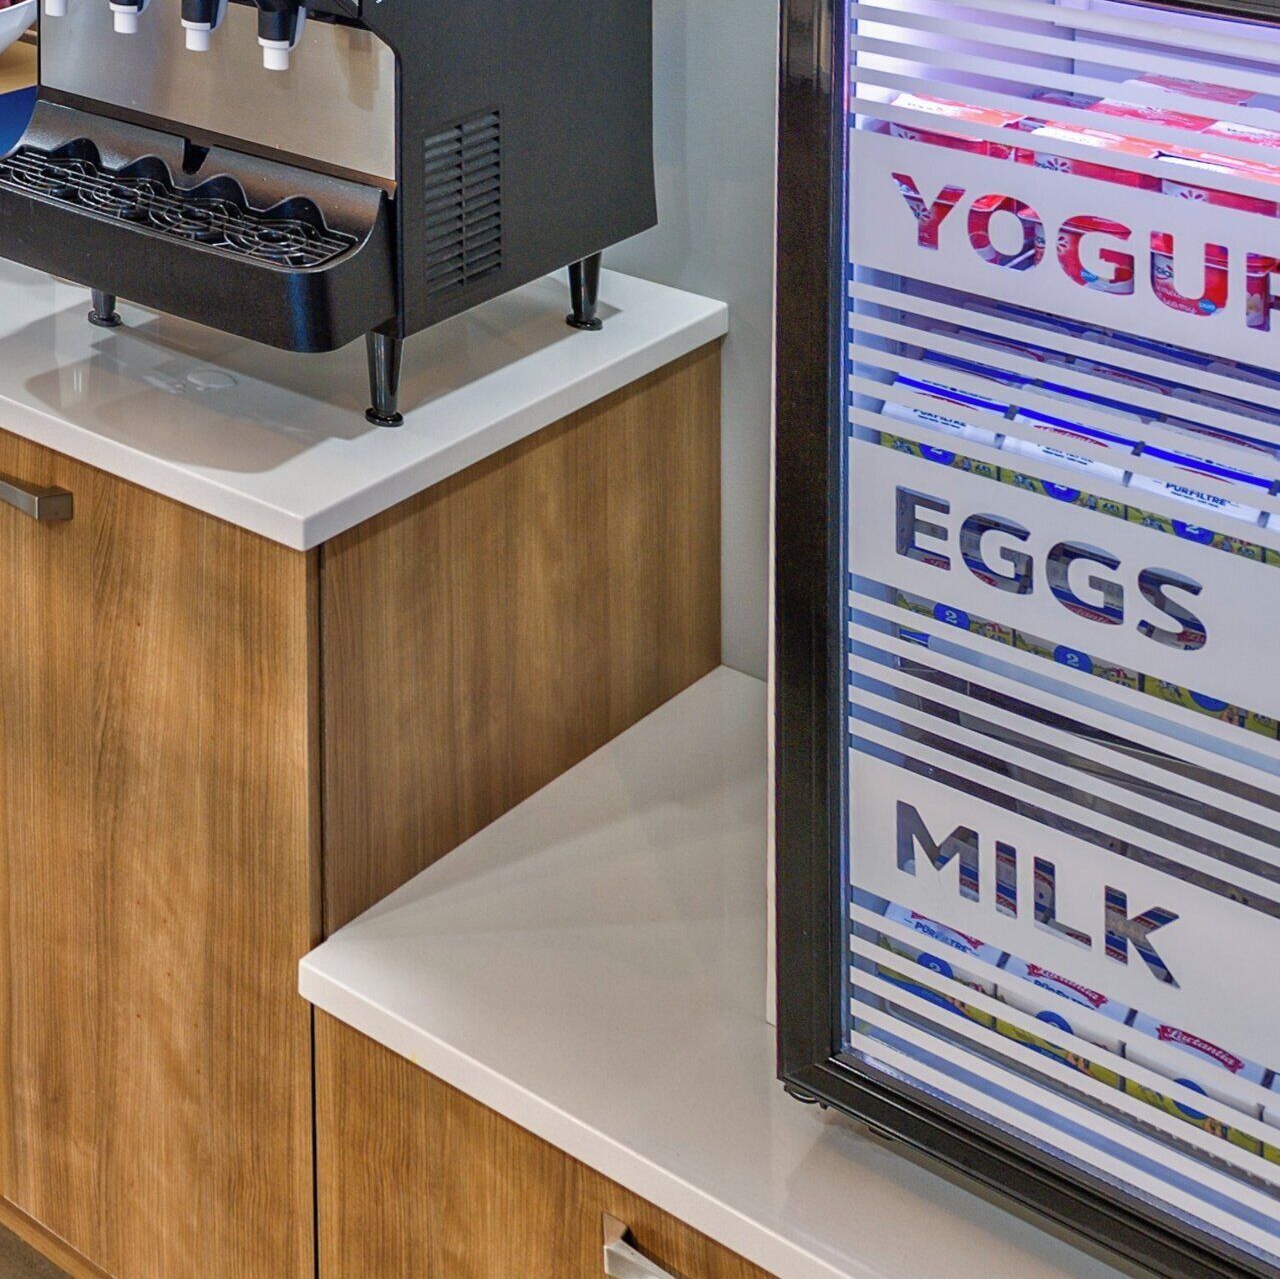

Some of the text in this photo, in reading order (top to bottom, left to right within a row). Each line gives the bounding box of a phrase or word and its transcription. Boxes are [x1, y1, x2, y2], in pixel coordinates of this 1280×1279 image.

[895, 484, 1208, 651] EGGS
[945, 609, 958, 624] 2
[1066, 653, 1079, 667] 2
[896, 799, 1182, 990] MILK
